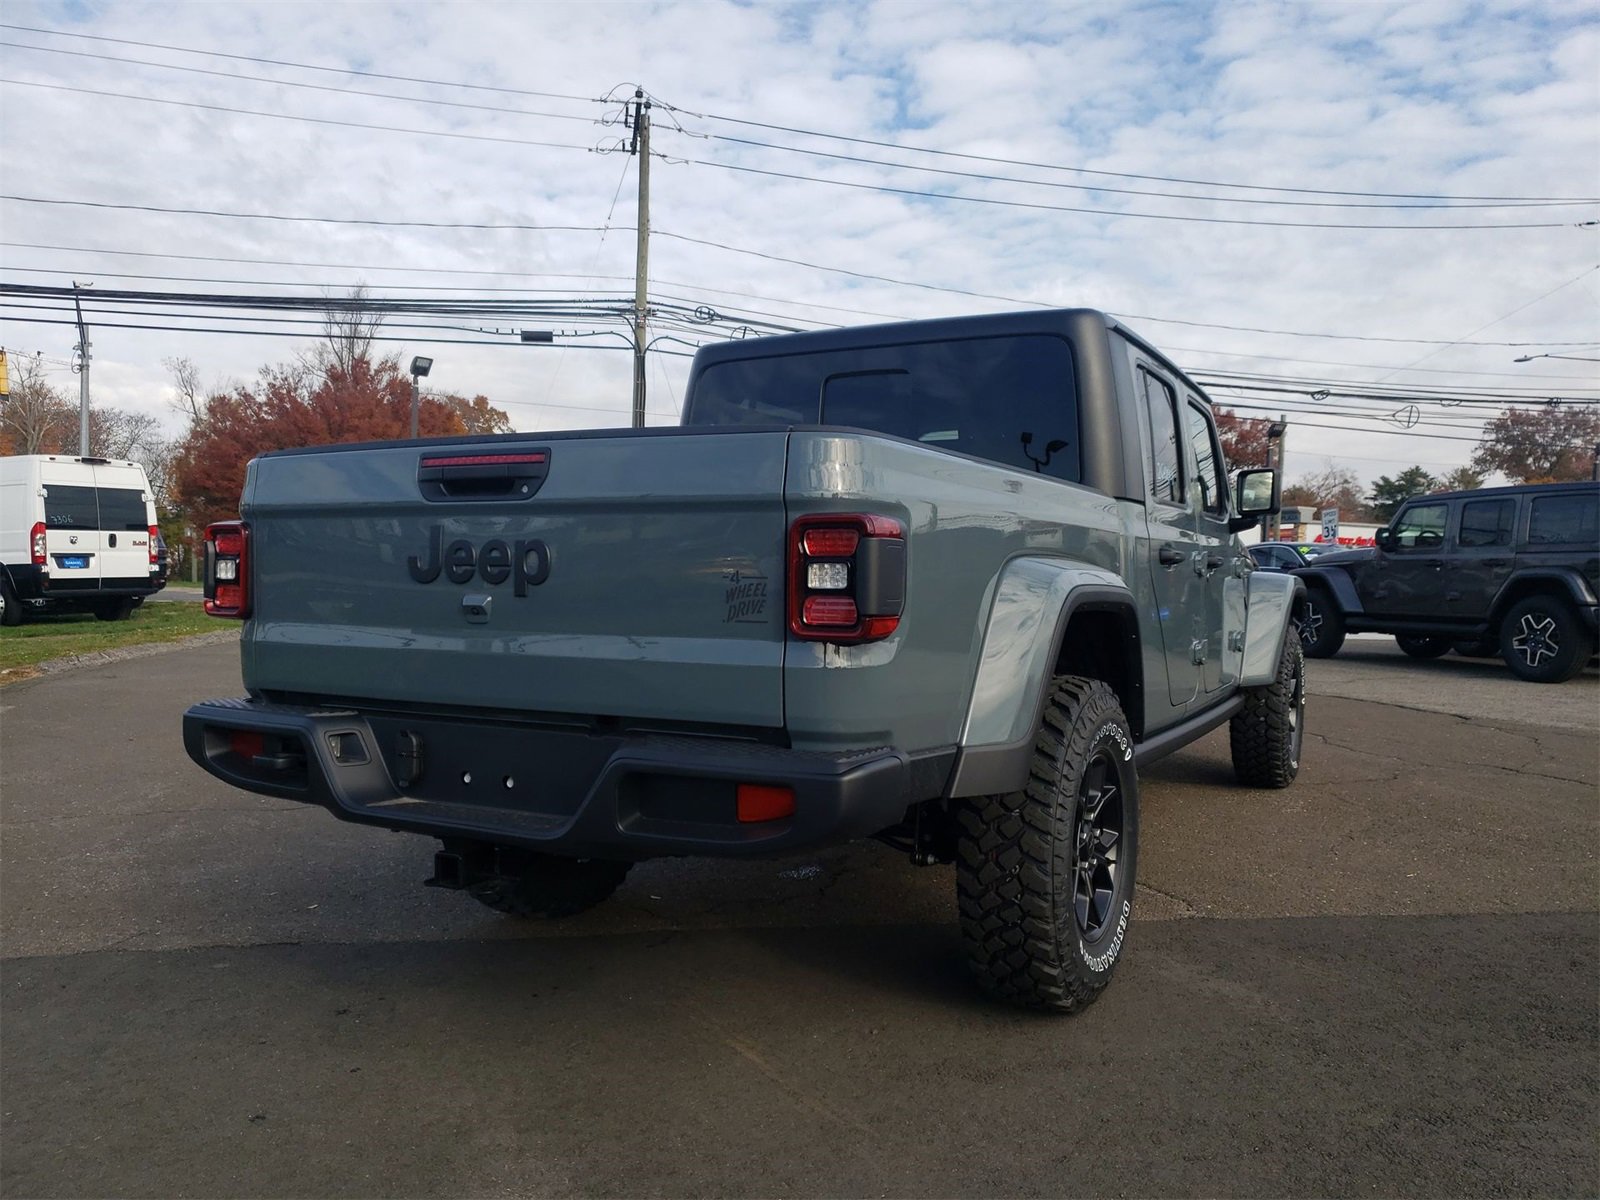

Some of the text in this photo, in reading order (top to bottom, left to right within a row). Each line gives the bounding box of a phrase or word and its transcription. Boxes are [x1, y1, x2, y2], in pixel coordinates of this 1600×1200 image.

[1323, 525, 1337, 538] 35
[407, 524, 552, 598] Jeep
[727, 570, 741, 584] 4
[725, 582, 767, 604] WHEEL
[726, 599, 767, 624] DRIVE
[1083, 900, 1131, 972] DESTINATION
